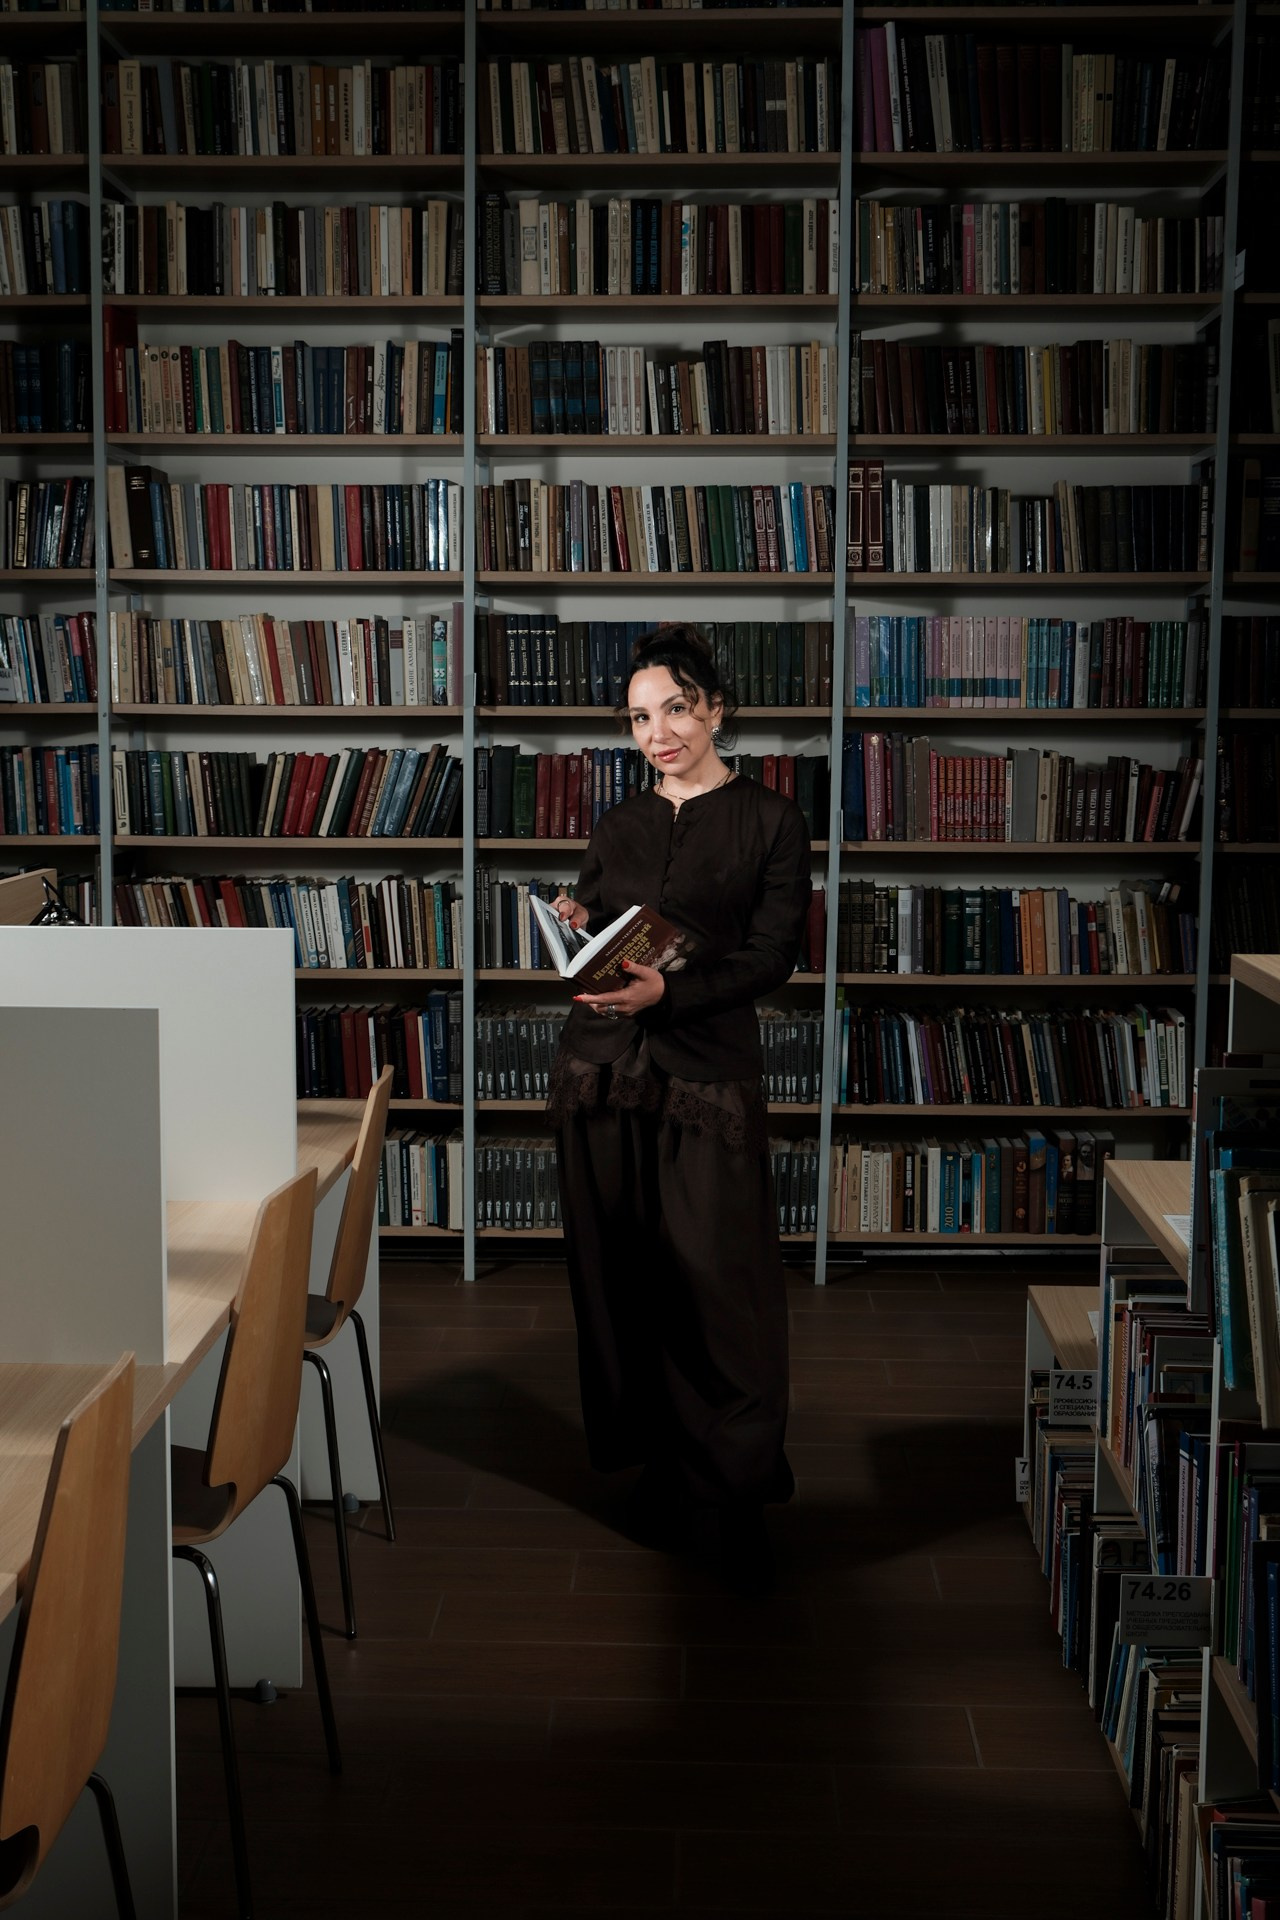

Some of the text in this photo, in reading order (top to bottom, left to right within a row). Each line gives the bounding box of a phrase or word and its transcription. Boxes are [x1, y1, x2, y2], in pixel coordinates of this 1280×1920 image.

[587, 79, 597, 112] ПРОМЕТЕЙ
[126, 100, 136, 142] Андрей Белый
[456, 239, 464, 276] ГУМИЛЕВ
[486, 208, 494, 274] БУЛГАКОВСКАЯ
[493, 208, 501, 274] ЭНЦИКЛОПЕДИЯ
[1200, 510, 1208, 536] ПИСАТЕЛИ
[340, 629, 348, 650] ЕСЕНИНЕ
[1105, 622, 1113, 633] Бог
[406, 630, 414, 668] АХМАТОВОЙ
[1104, 648, 1112, 664] Язык
[409, 686, 416, 696] ОБ
[1074, 789, 1084, 827] РАЗУМ СЕРДЦА
[1089, 788, 1098, 826] РАЗУМ СЕРДЦА
[1104, 788, 1113, 826] РАЗУМ СЕРДЦА
[592, 922, 653, 981] ЦЕНТРАЛЬНЫЙ
[605, 919, 644, 957] Михаил ЧЕРТОК
[944, 1206, 954, 1228] 2010
[1054, 1374, 1093, 1390] 74.5
[1128, 1582, 1191, 1600] 74.26
